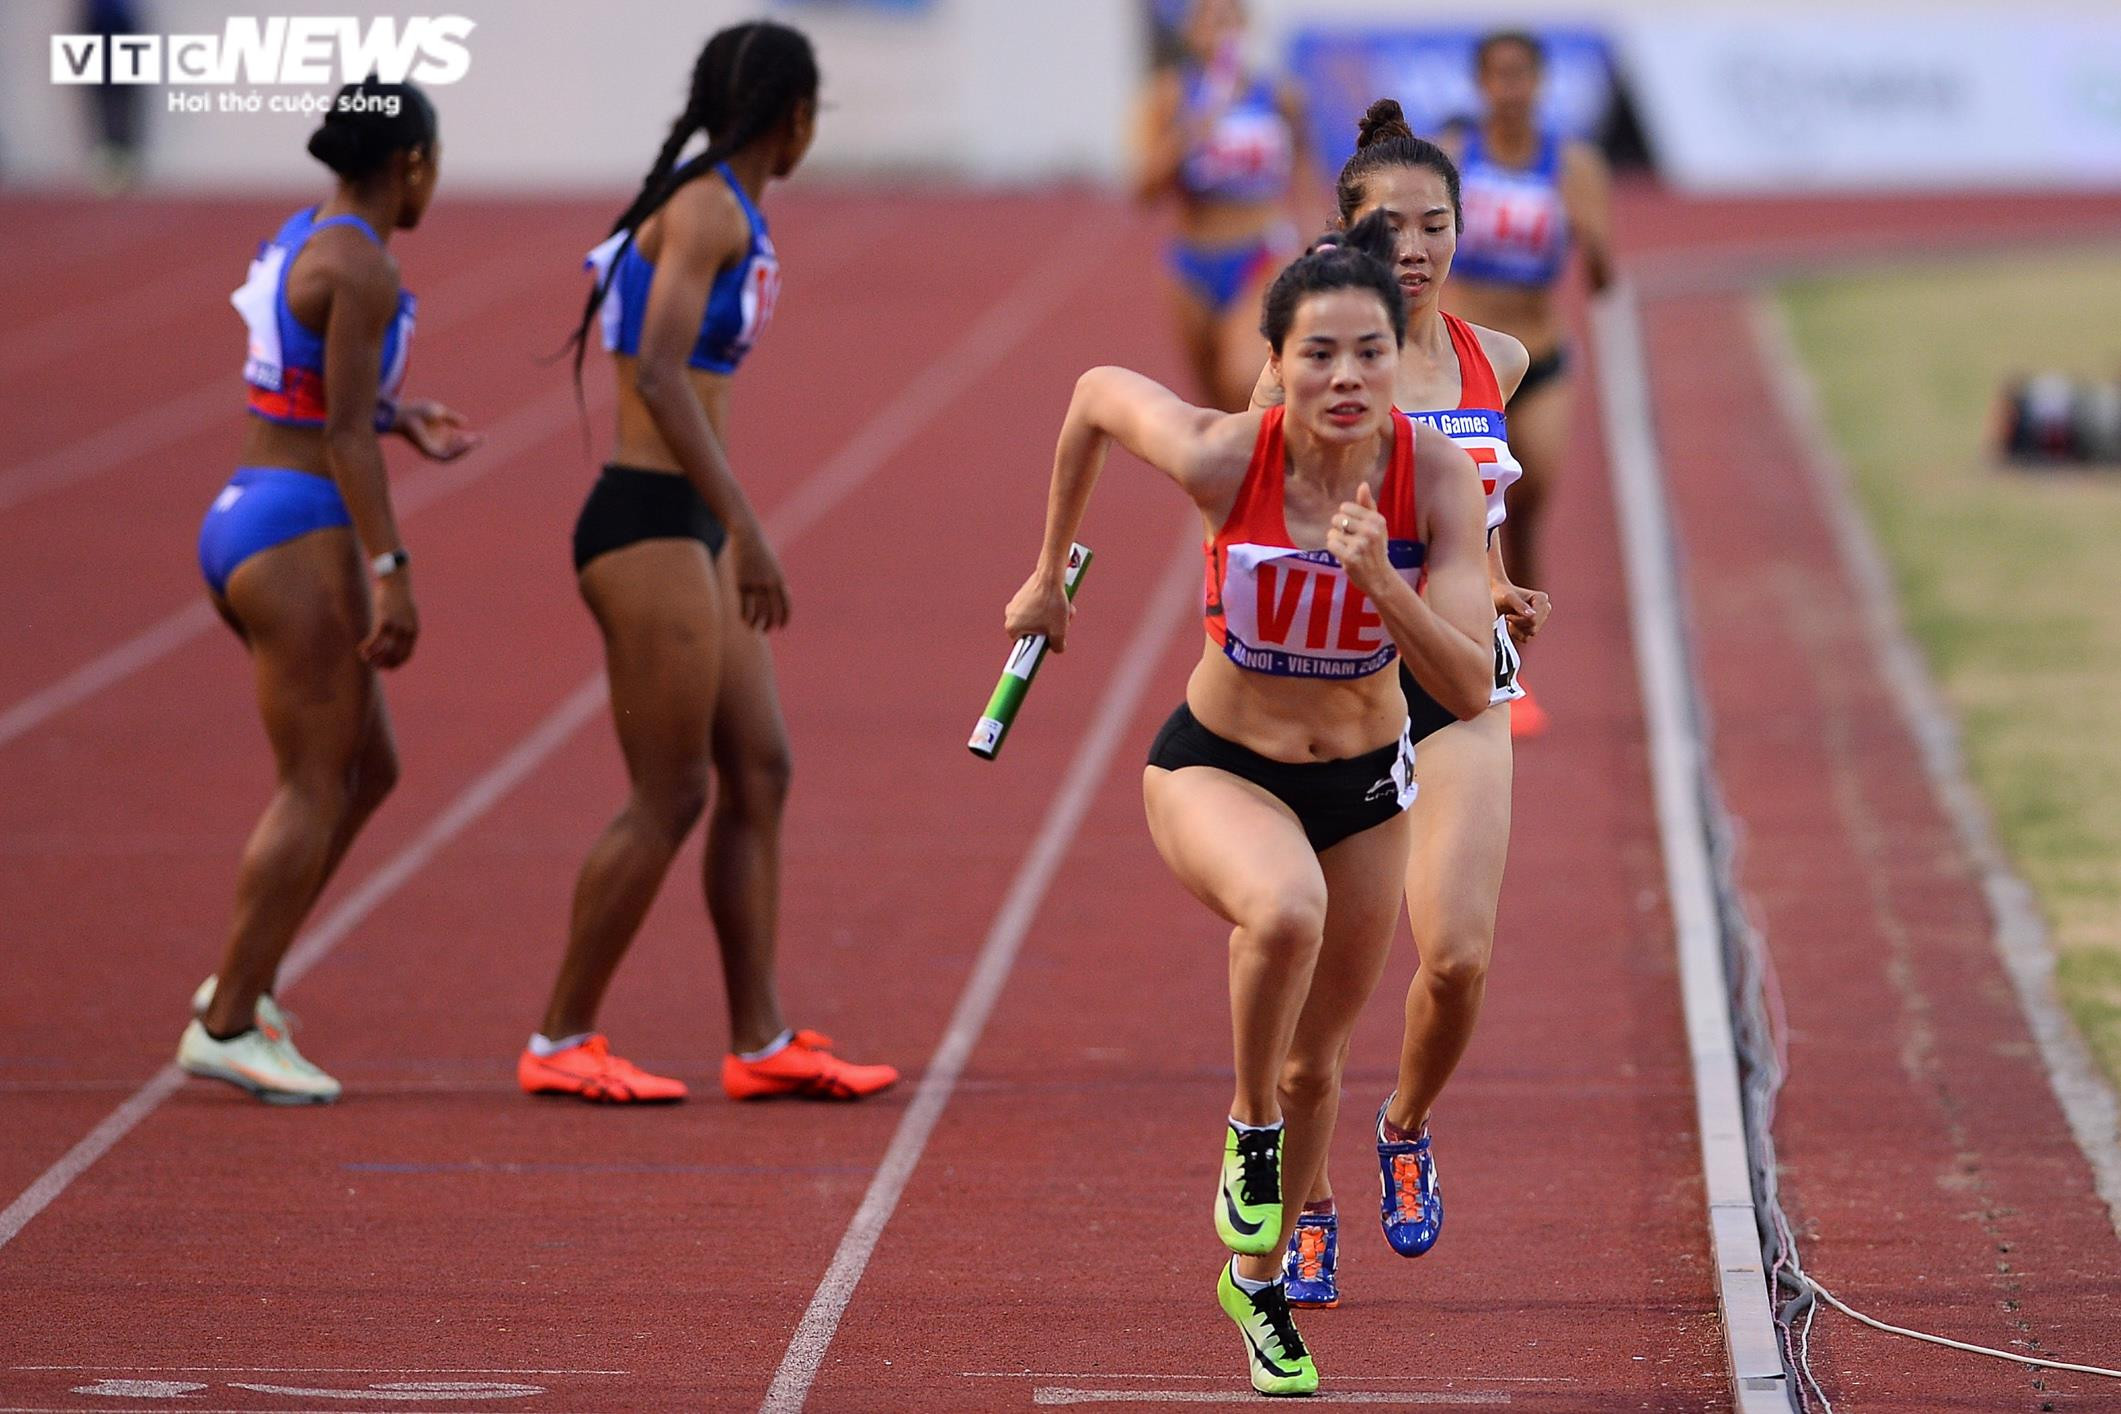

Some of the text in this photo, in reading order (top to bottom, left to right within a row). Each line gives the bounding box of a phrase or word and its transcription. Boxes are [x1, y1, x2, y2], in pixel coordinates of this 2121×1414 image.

[1440, 414, 1490, 435] Games
[1256, 564, 1383, 652] VIE
[1287, 655, 1356, 675] VIETNAM
